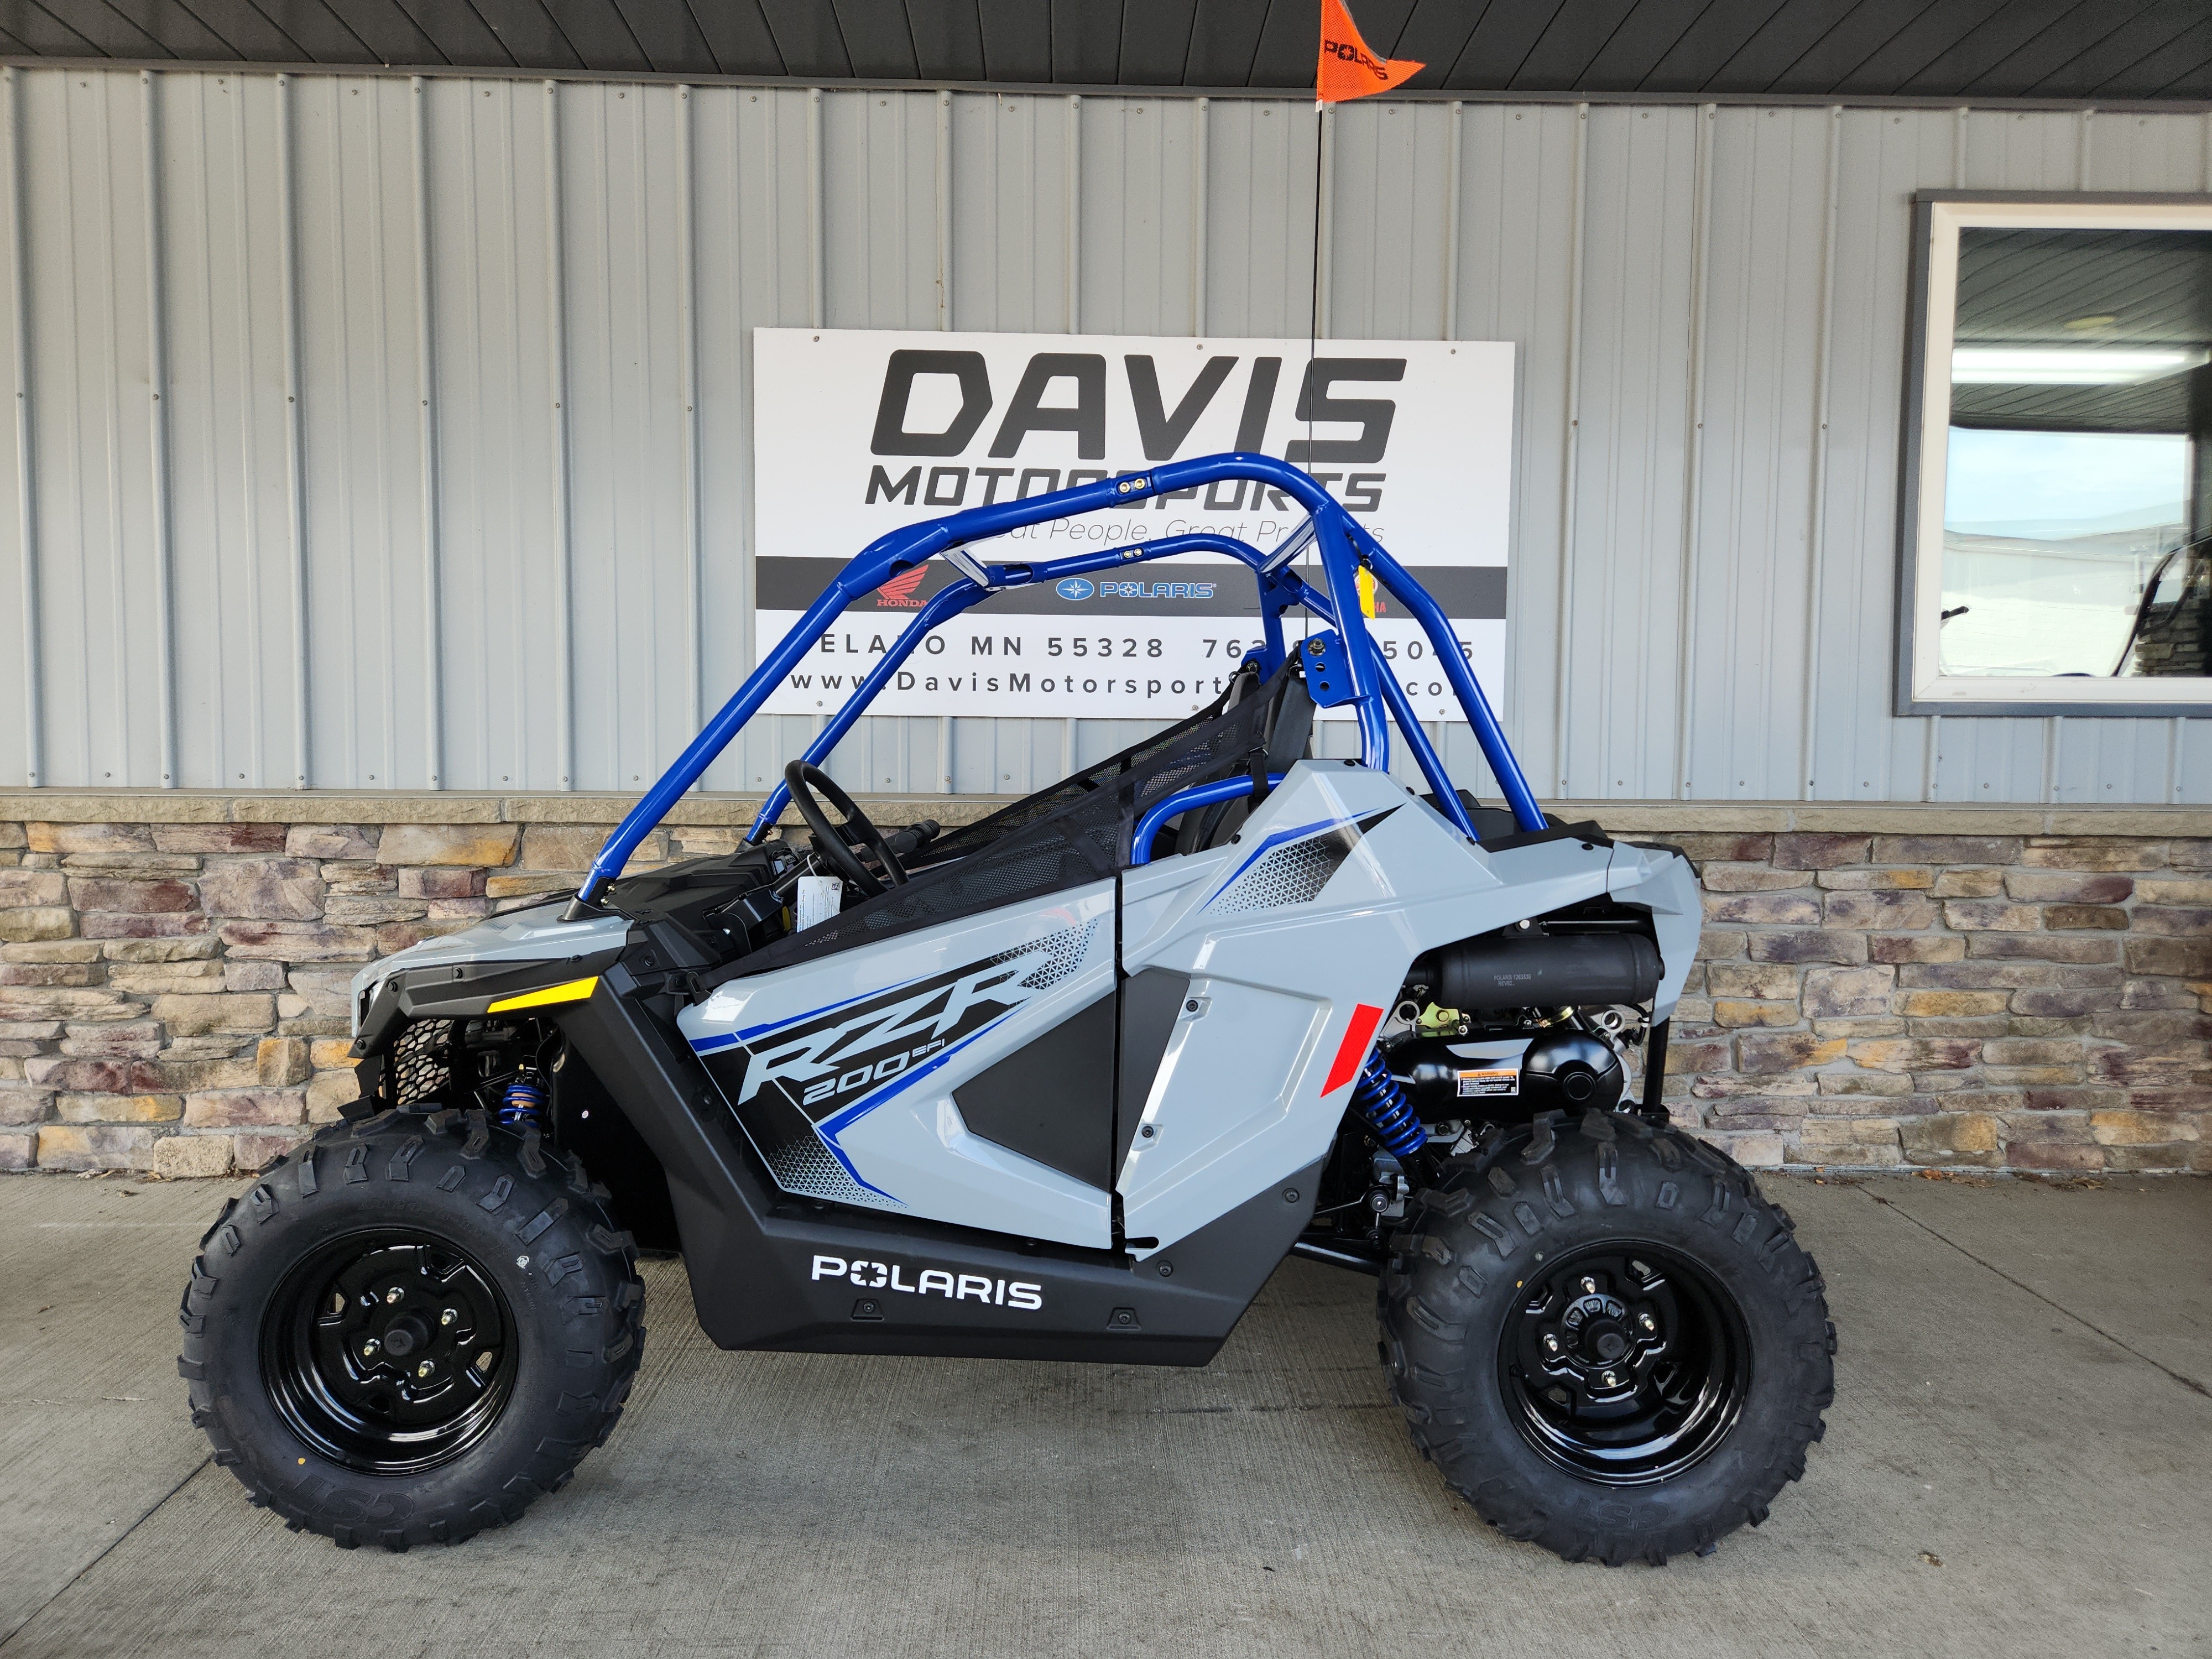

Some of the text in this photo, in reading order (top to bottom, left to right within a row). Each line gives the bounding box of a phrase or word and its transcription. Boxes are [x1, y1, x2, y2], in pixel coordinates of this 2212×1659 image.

[870, 349, 1407, 463] DAVIS
[877, 599, 928, 607] HONDA
[972, 635, 1021, 656] MN
[1047, 637, 1163, 658] 55328
[1383, 640, 1473, 660] 505
[738, 951, 1053, 1106] RZR
[803, 1037, 946, 1106] 200 EFI
[811, 1255, 1042, 1310] POLARIS
